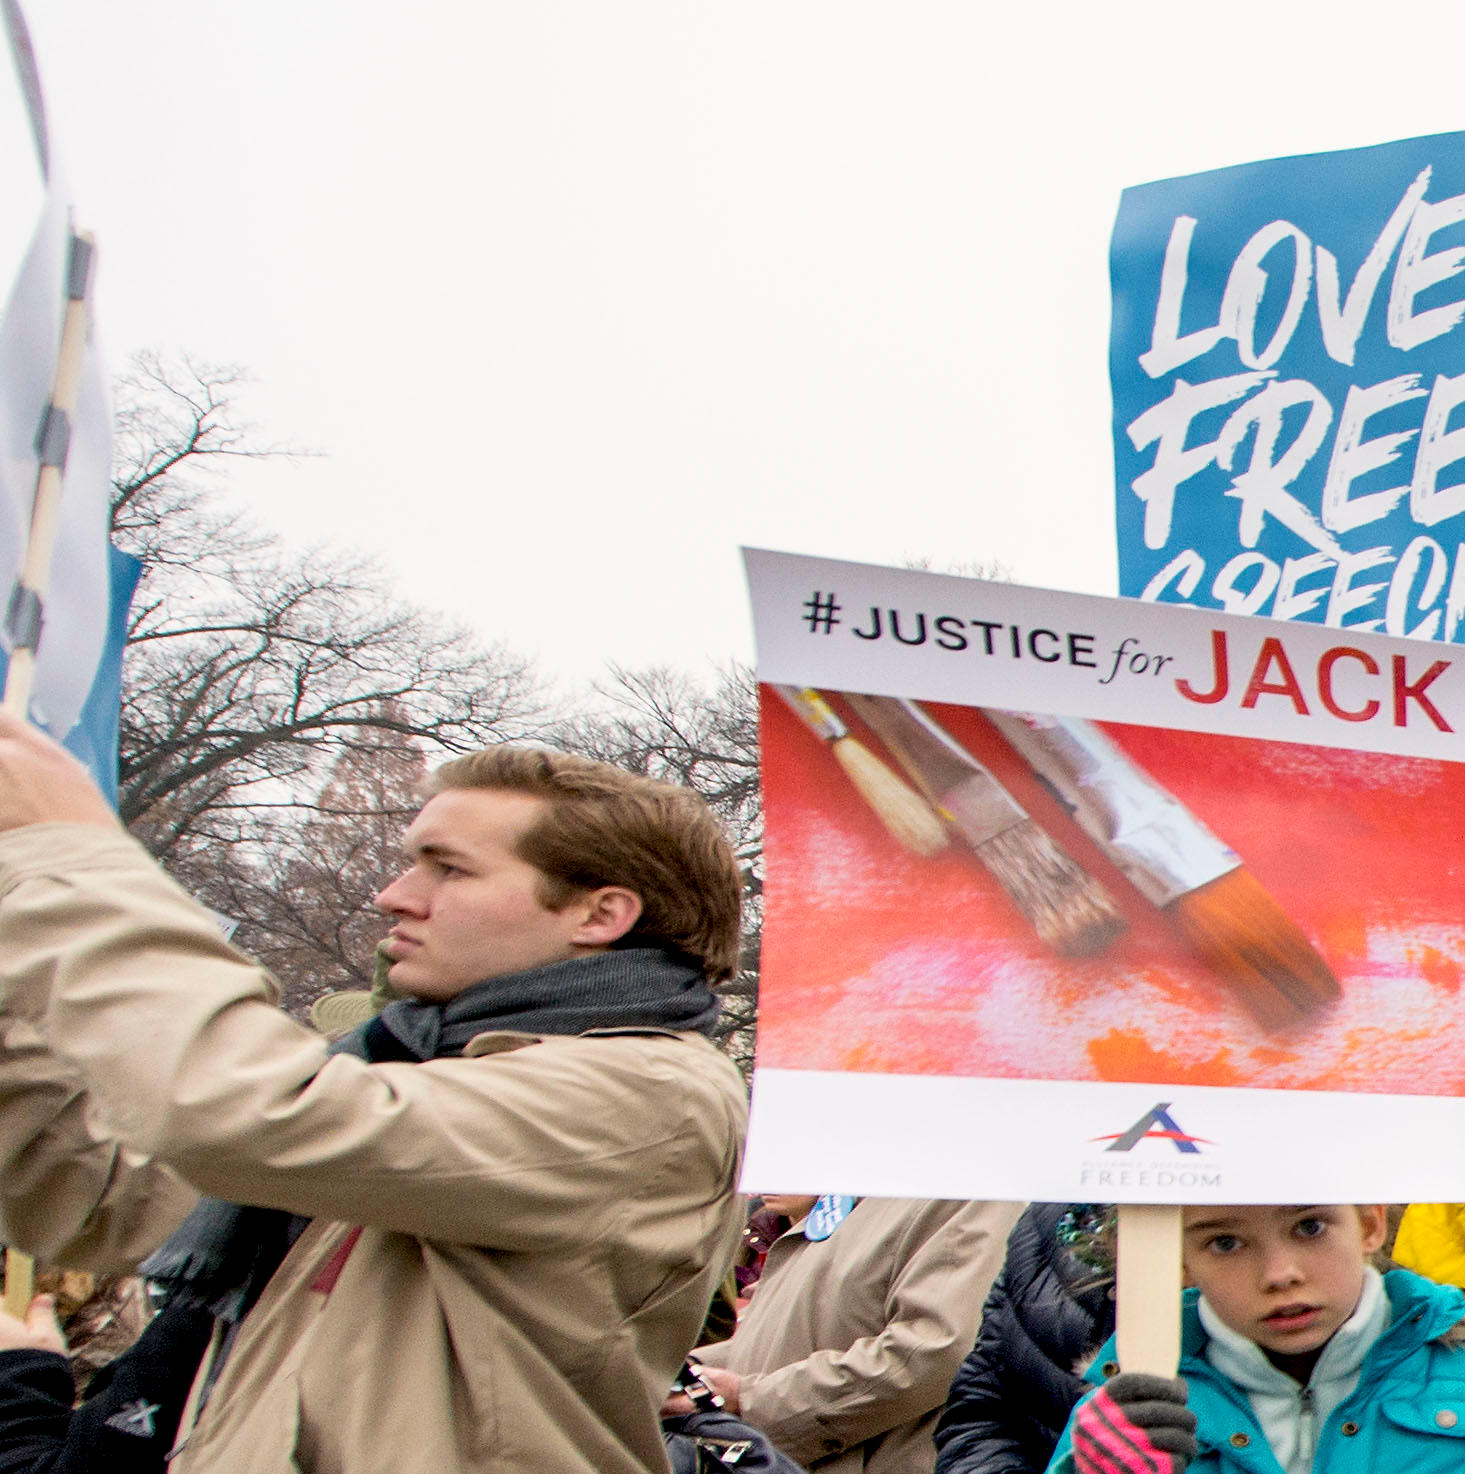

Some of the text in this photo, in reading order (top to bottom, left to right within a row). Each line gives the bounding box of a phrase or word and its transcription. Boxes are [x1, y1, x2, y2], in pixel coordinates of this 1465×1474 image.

[802, 591, 1456, 734] #JUSTICE for JACK
[1080, 1169, 1223, 1188] FREEDOM
